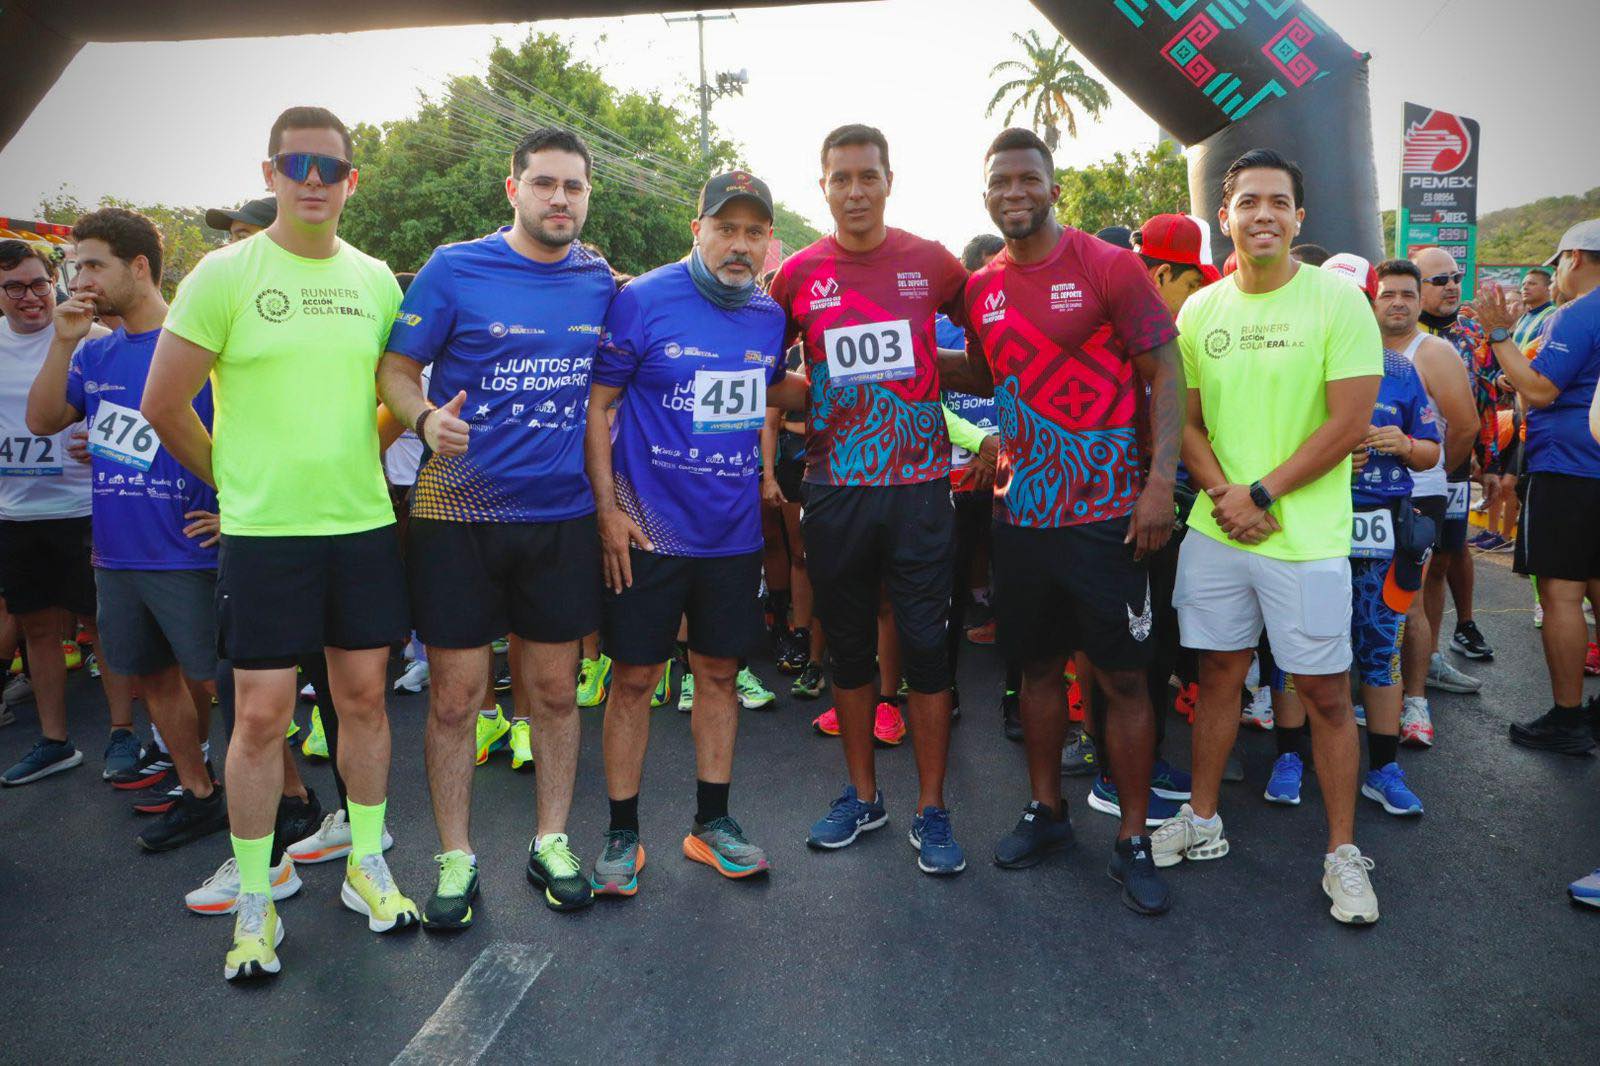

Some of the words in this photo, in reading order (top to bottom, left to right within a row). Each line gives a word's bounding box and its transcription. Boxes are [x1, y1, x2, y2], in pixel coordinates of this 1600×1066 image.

[1409, 176, 1473, 189] PEMEX
[300, 288, 360, 299] RUNNERS
[303, 306, 366, 318] COLATERAL
[1241, 324, 1290, 335] RUNNERS
[836, 330, 902, 368] 003
[1240, 339, 1289, 350] COLATERAL
[494, 358, 570, 376] ¡JUNTOS
[481, 377, 517, 391] LOS
[662, 394, 695, 412] LOS
[701, 378, 757, 414] 451
[97, 411, 153, 453] 476
[0, 437, 54, 463] 472
